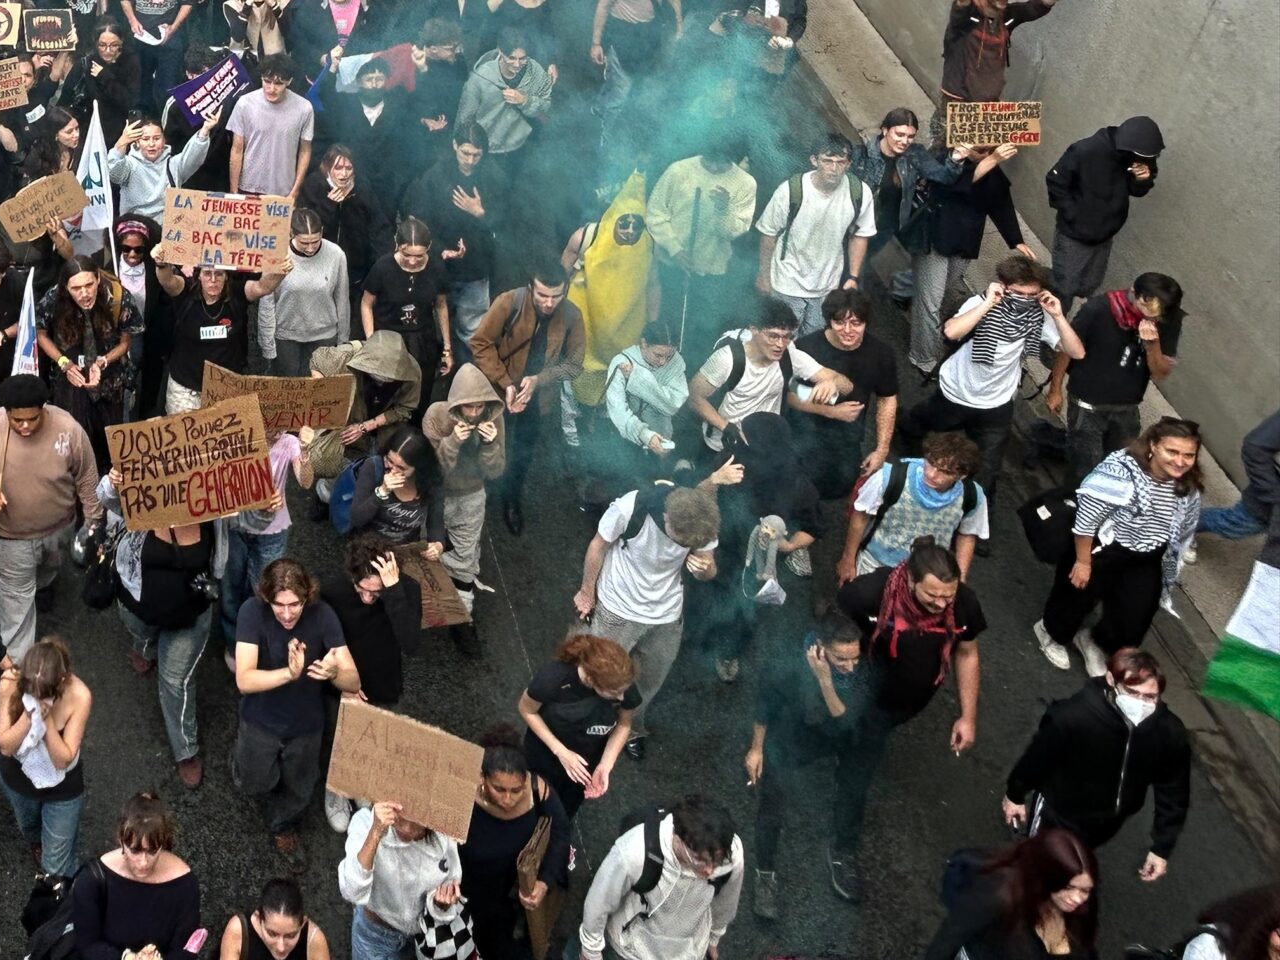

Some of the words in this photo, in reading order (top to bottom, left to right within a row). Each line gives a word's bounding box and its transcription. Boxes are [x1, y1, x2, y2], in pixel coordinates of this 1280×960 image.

[982, 103, 1016, 113] JEUNE
[174, 194, 192, 209] LA
[201, 198, 262, 216] JEUNESSE
[266, 201, 290, 217] VISE
[208, 214, 226, 227] LE
[233, 217, 260, 230] BAC
[165, 228, 182, 242] LA
[192, 231, 222, 246] BAC
[244, 231, 277, 250] VISE
[203, 249, 222, 264] LA
[229, 250, 263, 268] TÊTE
[112, 425, 177, 460] VOUS
[121, 447, 184, 485] FERMER
[120, 485, 157, 519] PAS
